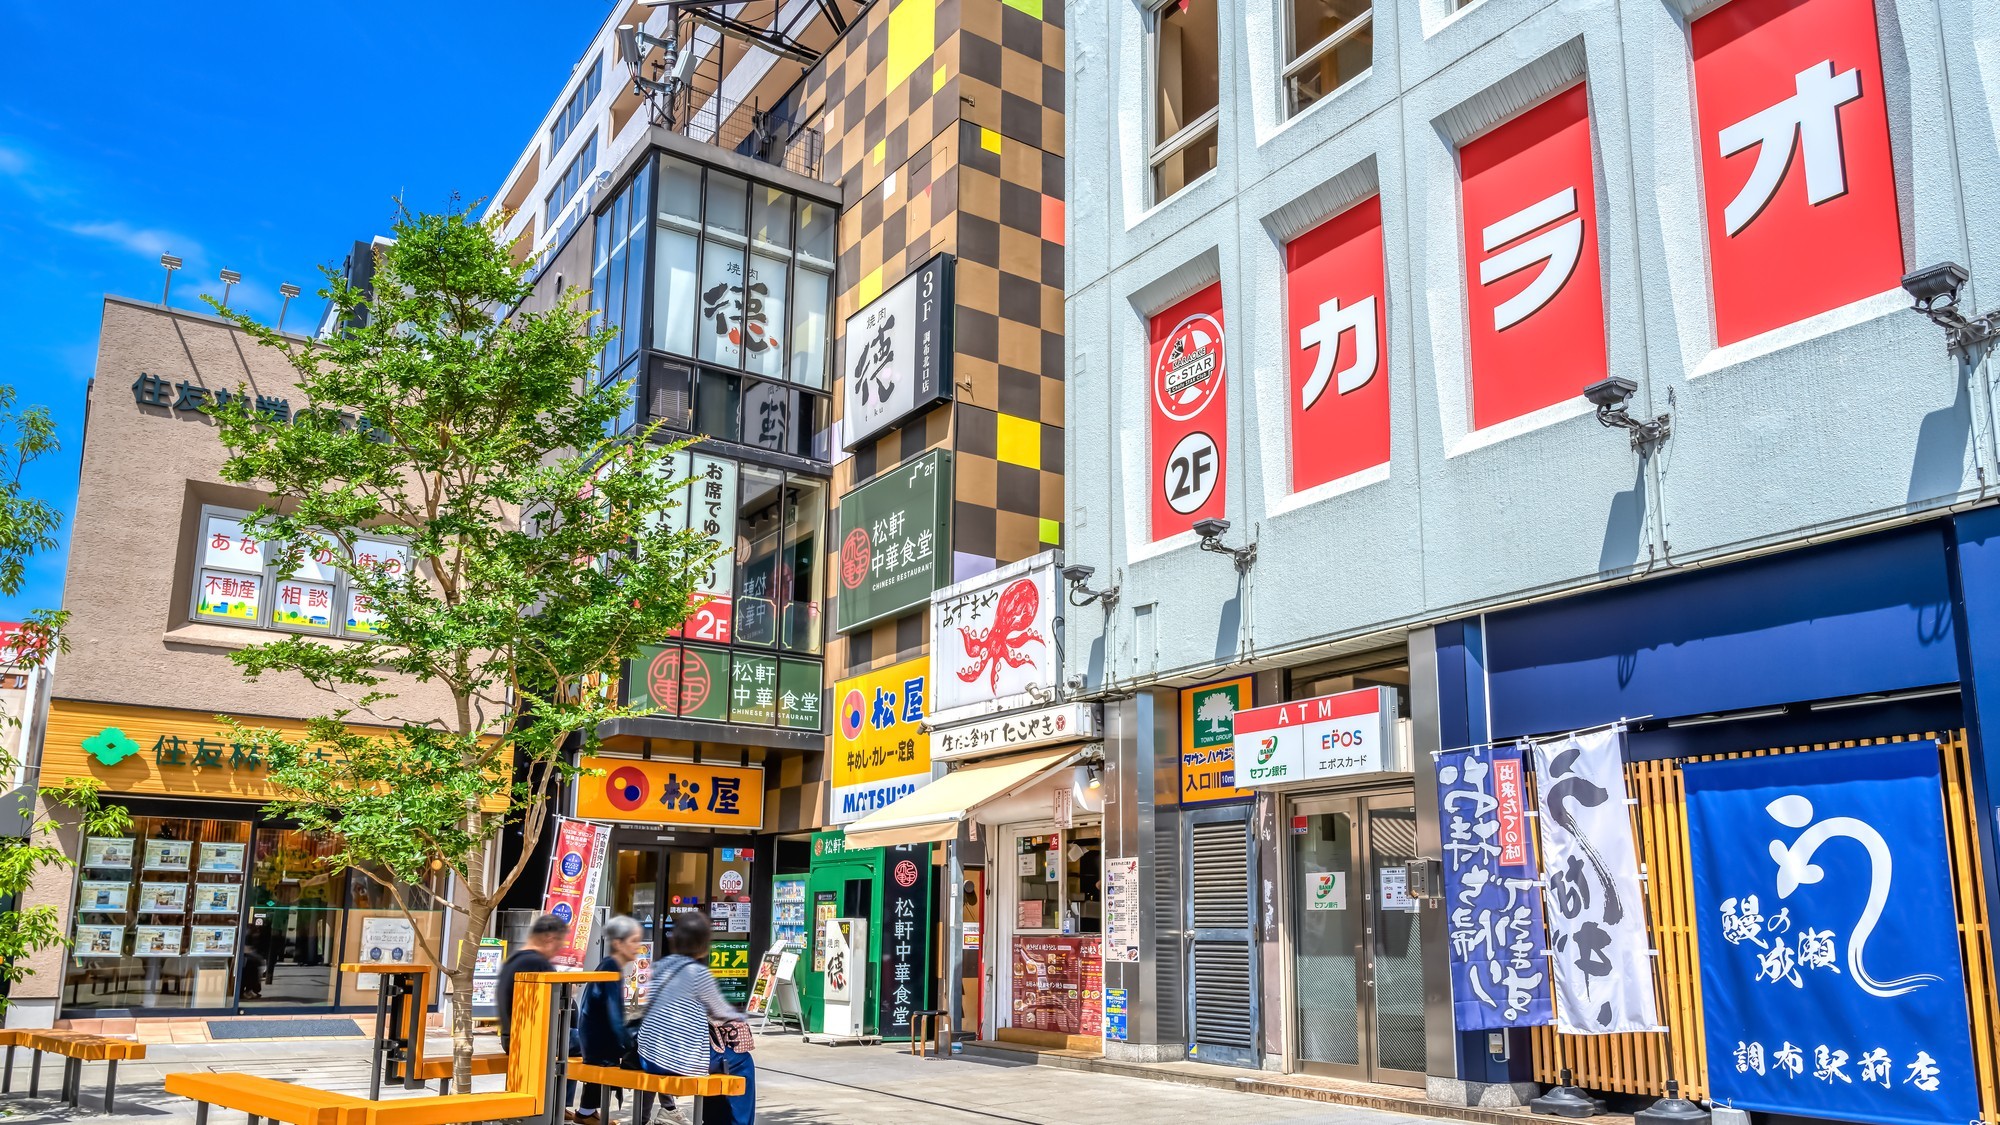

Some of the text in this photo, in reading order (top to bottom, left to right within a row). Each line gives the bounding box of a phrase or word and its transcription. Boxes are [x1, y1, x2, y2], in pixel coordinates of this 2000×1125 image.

[727, 261, 758, 281] 焼肉
[866, 307, 887, 330] 焼肉
[921, 270, 934, 394] 3F 調布北口店
[725, 345, 757, 360] tou
[924, 461, 935, 477] 2F
[1170, 445, 1212, 502] 2F
[871, 509, 906, 547] 松軒
[871, 528, 933, 579] 中華食堂
[872, 561, 933, 592] CHINESE RESTAURANT
[943, 589, 999, 629] あずまや
[696, 610, 728, 641] 2F
[732, 660, 776, 686] 松軒
[733, 684, 819, 713] 中華食堂
[871, 676, 924, 731] 松屋
[1278, 698, 1332, 725] ATM
[732, 707, 814, 722] CHINESE RESTAURANT
[942, 714, 1055, 752] 生だこ釜ゆで たこやき
[1200, 732, 1233, 744] TOWN GROUP
[1321, 729, 1363, 751] EPOS
[846, 738, 915, 772] 牛めし・カレー・定食
[1318, 754, 1367, 771] エポスカード
[1185, 773, 1210, 793] 入口
[1249, 764, 1287, 780] セブン銀行
[659, 772, 741, 815] 松屋
[722, 879, 736, 890] 500
[842, 923, 849, 934] 3F
[711, 951, 730, 967] 2F
[892, 897, 915, 1027] 松軒中華食堂
[1732, 1040, 1941, 1092] 調布駅前店
